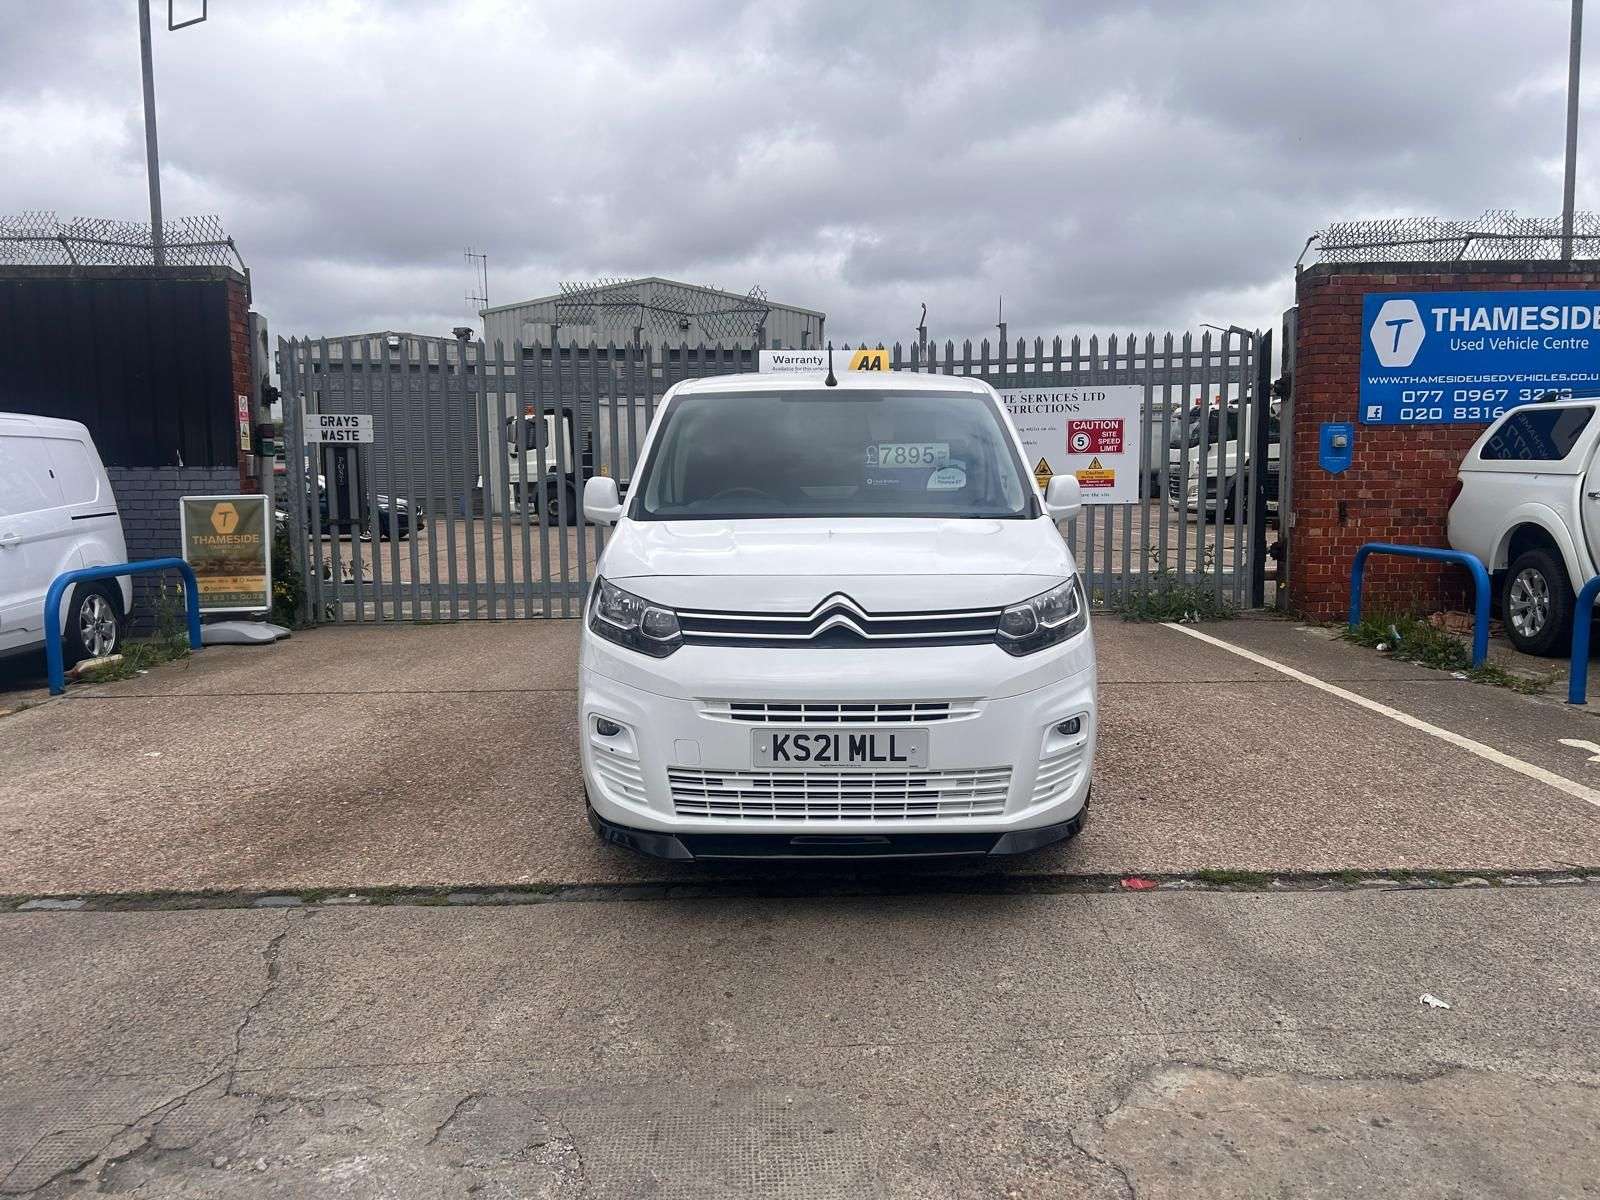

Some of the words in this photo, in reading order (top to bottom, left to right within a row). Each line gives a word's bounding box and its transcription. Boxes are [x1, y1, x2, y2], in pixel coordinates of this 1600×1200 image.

[1450, 338, 1484, 350] Used
[1489, 337, 1538, 350] Vehicle
[1543, 336, 1589, 349] Centre
[773, 355, 824, 365] Warranty
[857, 355, 881, 370] AA
[1020, 393, 1079, 403] SERVICES
[1083, 391, 1106, 401] LTD
[1402, 390, 1444, 403] 077
[1453, 389, 1508, 402] 0967
[1400, 408, 1442, 420] 020
[320, 416, 359, 427] GRAYS
[1072, 421, 1119, 430] CAUTION
[321, 430, 360, 441] WASTE
[1077, 437, 1085, 447] 5
[192, 534, 260, 545] THAMESIDE
[772, 734, 839, 762] KS21
[848, 734, 907, 762] MLL
